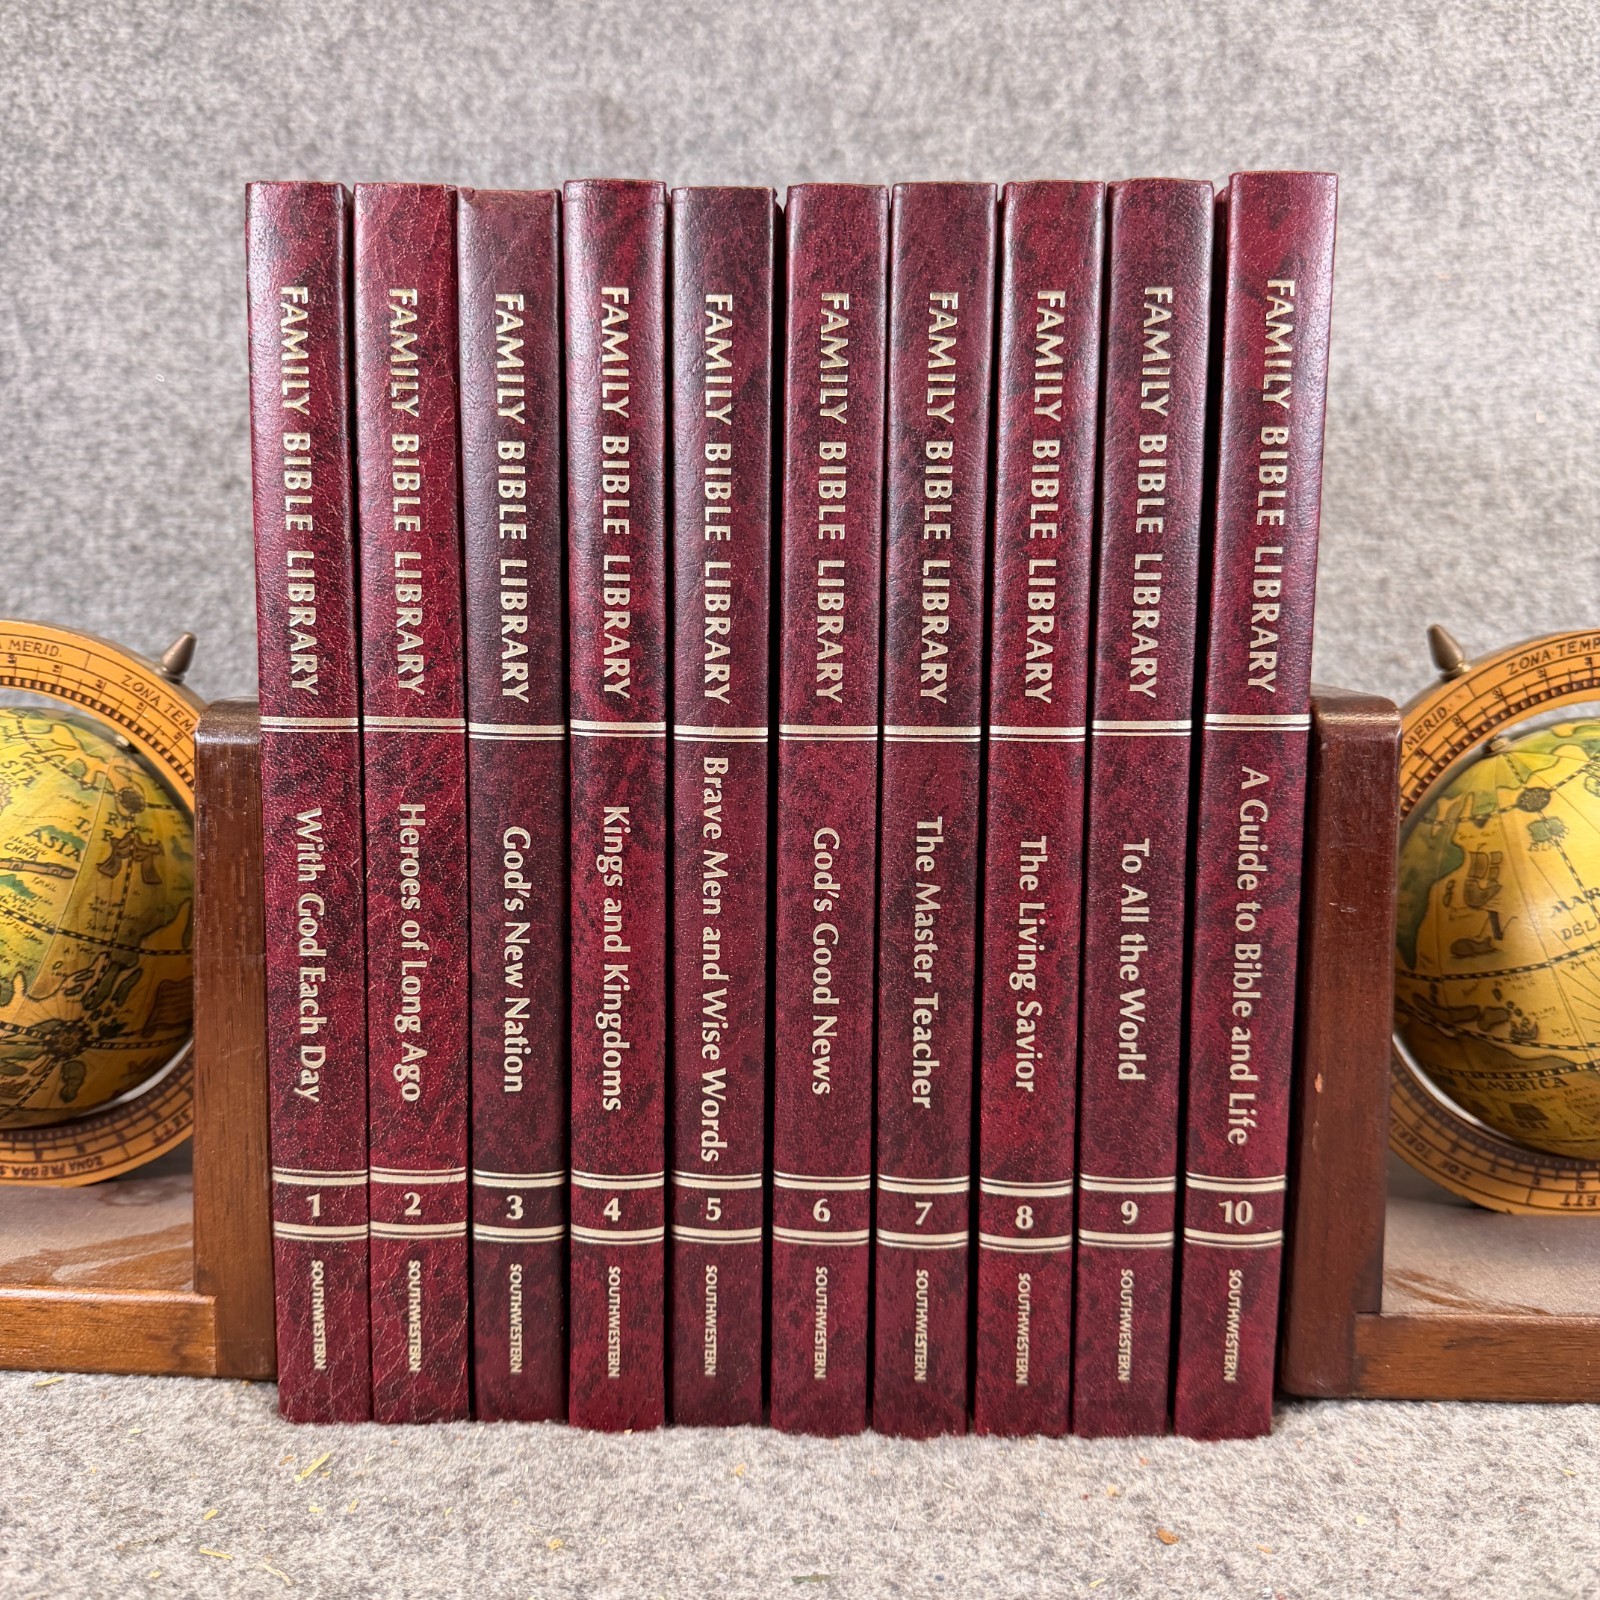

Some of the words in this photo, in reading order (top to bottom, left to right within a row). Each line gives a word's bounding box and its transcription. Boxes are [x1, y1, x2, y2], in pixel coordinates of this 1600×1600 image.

[279, 284, 310, 415] FAMILY
[388, 286, 419, 417] FAMILY
[495, 293, 525, 424] FAMILY
[600, 287, 629, 418] FAMILY
[704, 294, 733, 425] FAMILY
[820, 293, 849, 424] FAMILY
[927, 292, 958, 423] FAMILY
[1034, 291, 1065, 422] FAMILY
[1141, 287, 1173, 416] FAMILY
[1263, 279, 1294, 410] FAMILY
[281, 431, 313, 531] BIBLE
[391, 433, 420, 531] BIBLE
[496, 441, 526, 539] BIBLE
[601, 436, 629, 534] BIBLE
[705, 443, 731, 540] BIBLE
[818, 442, 846, 539] BIBLE
[924, 441, 953, 539] BIBLE
[1030, 440, 1060, 538] BIBLE
[1136, 434, 1167, 533] BIBLE
[1257, 425, 1289, 525] BIBLE
[8, 639, 62, 658] MERID.
[285, 550, 318, 695] LIBRARY
[395, 551, 424, 695] LIBRARY
[500, 559, 529, 703] LIBRARY
[604, 555, 630, 698] LIBRARY
[704, 560, 731, 704] LIBRARY
[816, 560, 845, 703] LIBRARY
[921, 560, 950, 703] LIBRARY
[1025, 560, 1056, 703] LIBRARY
[1129, 554, 1163, 698] LIBRARY
[1248, 547, 1284, 692] LIBRARY
[1506, 649, 1551, 675] ZONA
[121, 674, 160, 707] ZONA
[164, 703, 195, 735] TEM
[703, 757, 728, 839] Brave
[1242, 766, 1269, 789] A
[25, 829, 81, 863] ASIA
[296, 807, 325, 881] With
[399, 804, 425, 909] Heroes
[503, 826, 532, 911] God's
[596, 807, 631, 886] Kings
[703, 850, 728, 914] Men
[813, 827, 840, 911] God's
[916, 816, 943, 871] The
[1020, 836, 1048, 890] The
[1122, 838, 1149, 873] To
[1237, 799, 1268, 890] Guide
[298, 893, 326, 956] God
[401, 920, 426, 950] of
[604, 898, 630, 952] and
[914, 883, 941, 981] Master
[1009, 903, 1045, 990] Living
[1121, 884, 1149, 922] All
[1236, 901, 1261, 931] to
[299, 967, 327, 1034] Each
[394, 961, 427, 1033] Long
[504, 922, 530, 988] New
[703, 927, 729, 981] and
[813, 923, 839, 994] Good
[1120, 933, 1148, 981] the
[1233, 944, 1262, 1017] Bible
[504, 998, 531, 1092] Nation
[596, 964, 630, 1110] Kingdoms
[702, 988, 728, 1060] Wise
[812, 1000, 839, 1094] News
[912, 993, 939, 1108] Teacher
[1016, 1001, 1043, 1092] Savior
[1118, 988, 1146, 1080] World
[1230, 1027, 1258, 1081] and
[294, 1045, 326, 1102] Day
[393, 1042, 420, 1101] Ago
[701, 1068, 727, 1162] Words
[1228, 1093, 1256, 1144] Life
[1465, 1077, 1570, 1092] AMERICA
[306, 1193, 320, 1217] 1
[403, 1191, 421, 1216] 2
[505, 1194, 523, 1220] 3
[602, 1197, 621, 1221] 4
[705, 1197, 721, 1221] 5
[812, 1198, 830, 1222] 6
[915, 1201, 932, 1225] 7
[1014, 1205, 1033, 1229] 8
[1120, 1200, 1138, 1224] 9
[1218, 1200, 1253, 1225] 10
[309, 1259, 326, 1370] SOUTHWESTERN
[407, 1259, 421, 1373] SOUTHWESTERN
[509, 1263, 522, 1373] SOUTHWESTERN
[607, 1265, 621, 1377] SOUTHWESTERN
[704, 1264, 717, 1375] SOUTHWESTERN
[814, 1266, 828, 1378] SOUTHWESTERN
[914, 1269, 928, 1380] SOUTHWESTERN
[1015, 1272, 1031, 1384] SOUTHWESTERN
[1117, 1268, 1133, 1381] SOUTHWESTERN
[1223, 1269, 1242, 1381] SOUTHWESTERN
